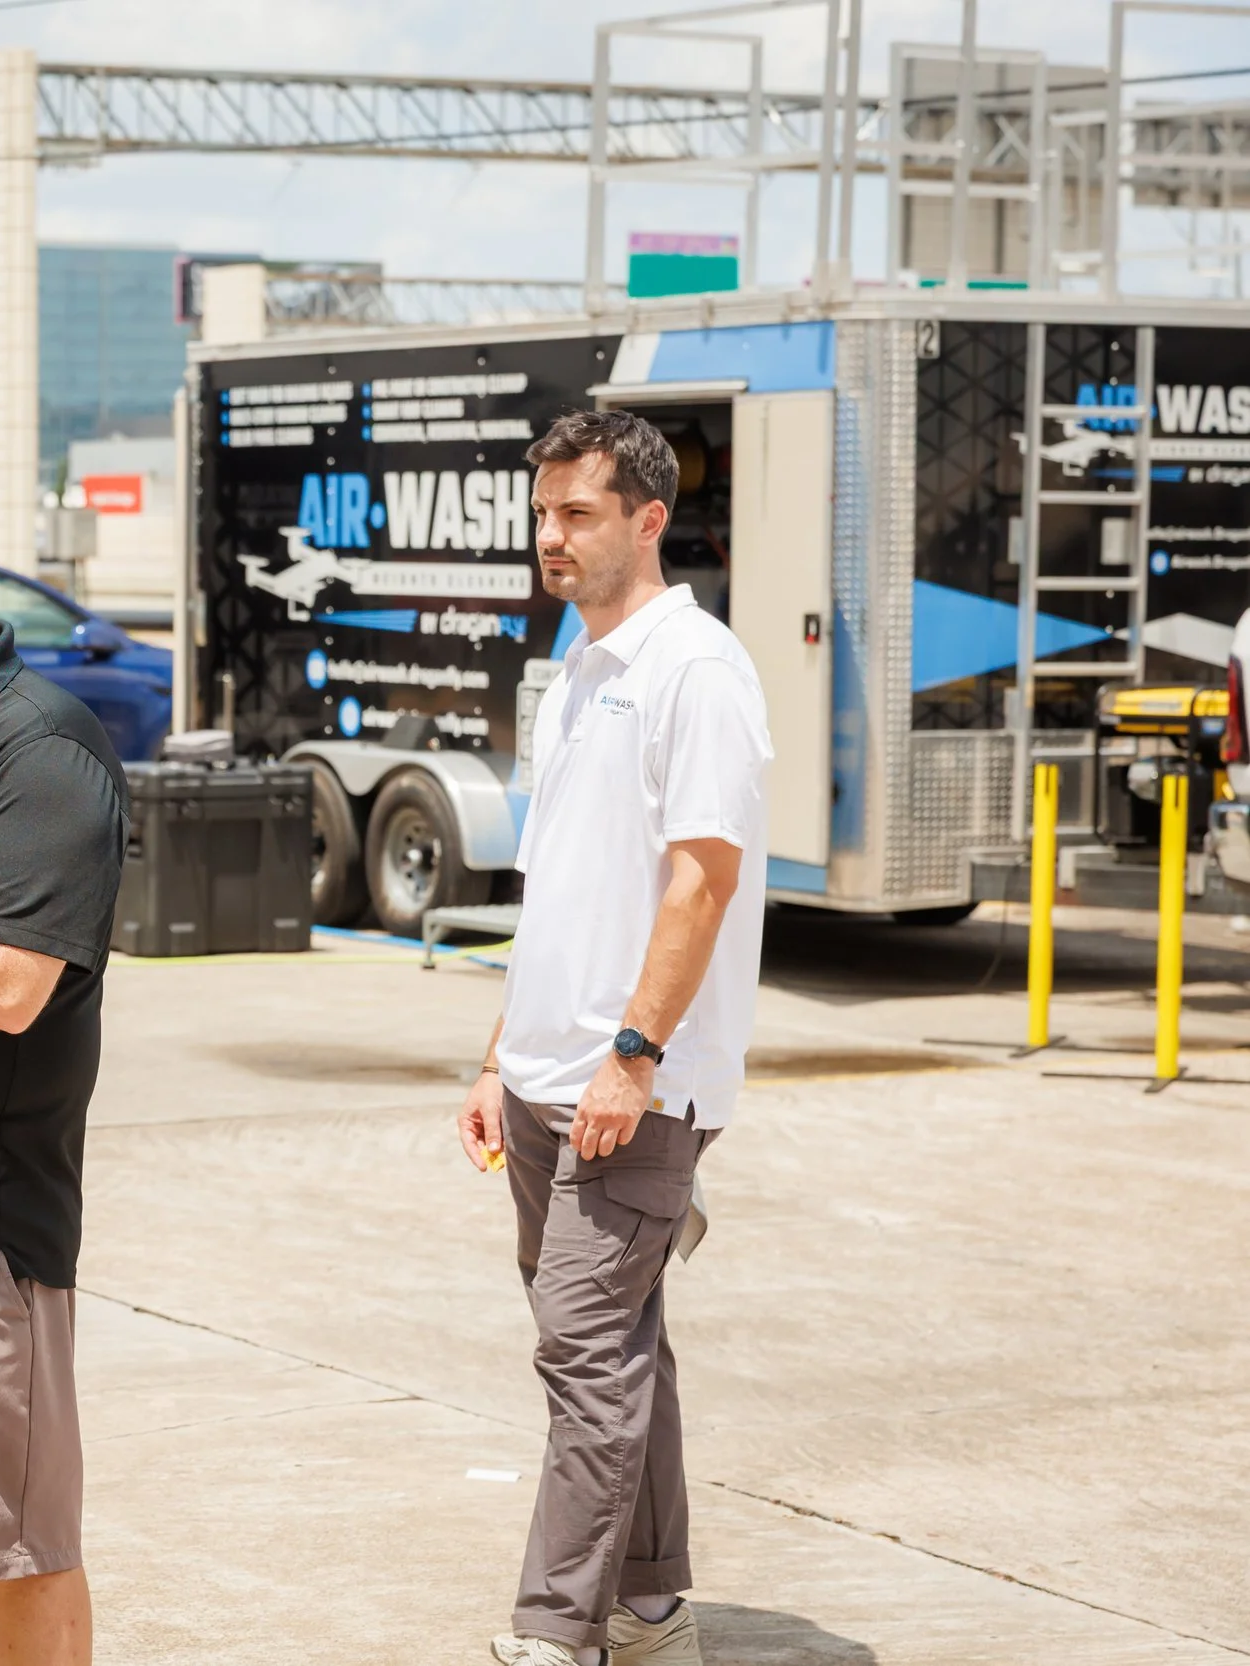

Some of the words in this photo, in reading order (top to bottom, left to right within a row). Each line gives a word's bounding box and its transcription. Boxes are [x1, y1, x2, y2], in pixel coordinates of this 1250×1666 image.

[922, 322, 936, 356] 2
[299, 473, 371, 549] AIR
[384, 470, 530, 550] WASH
